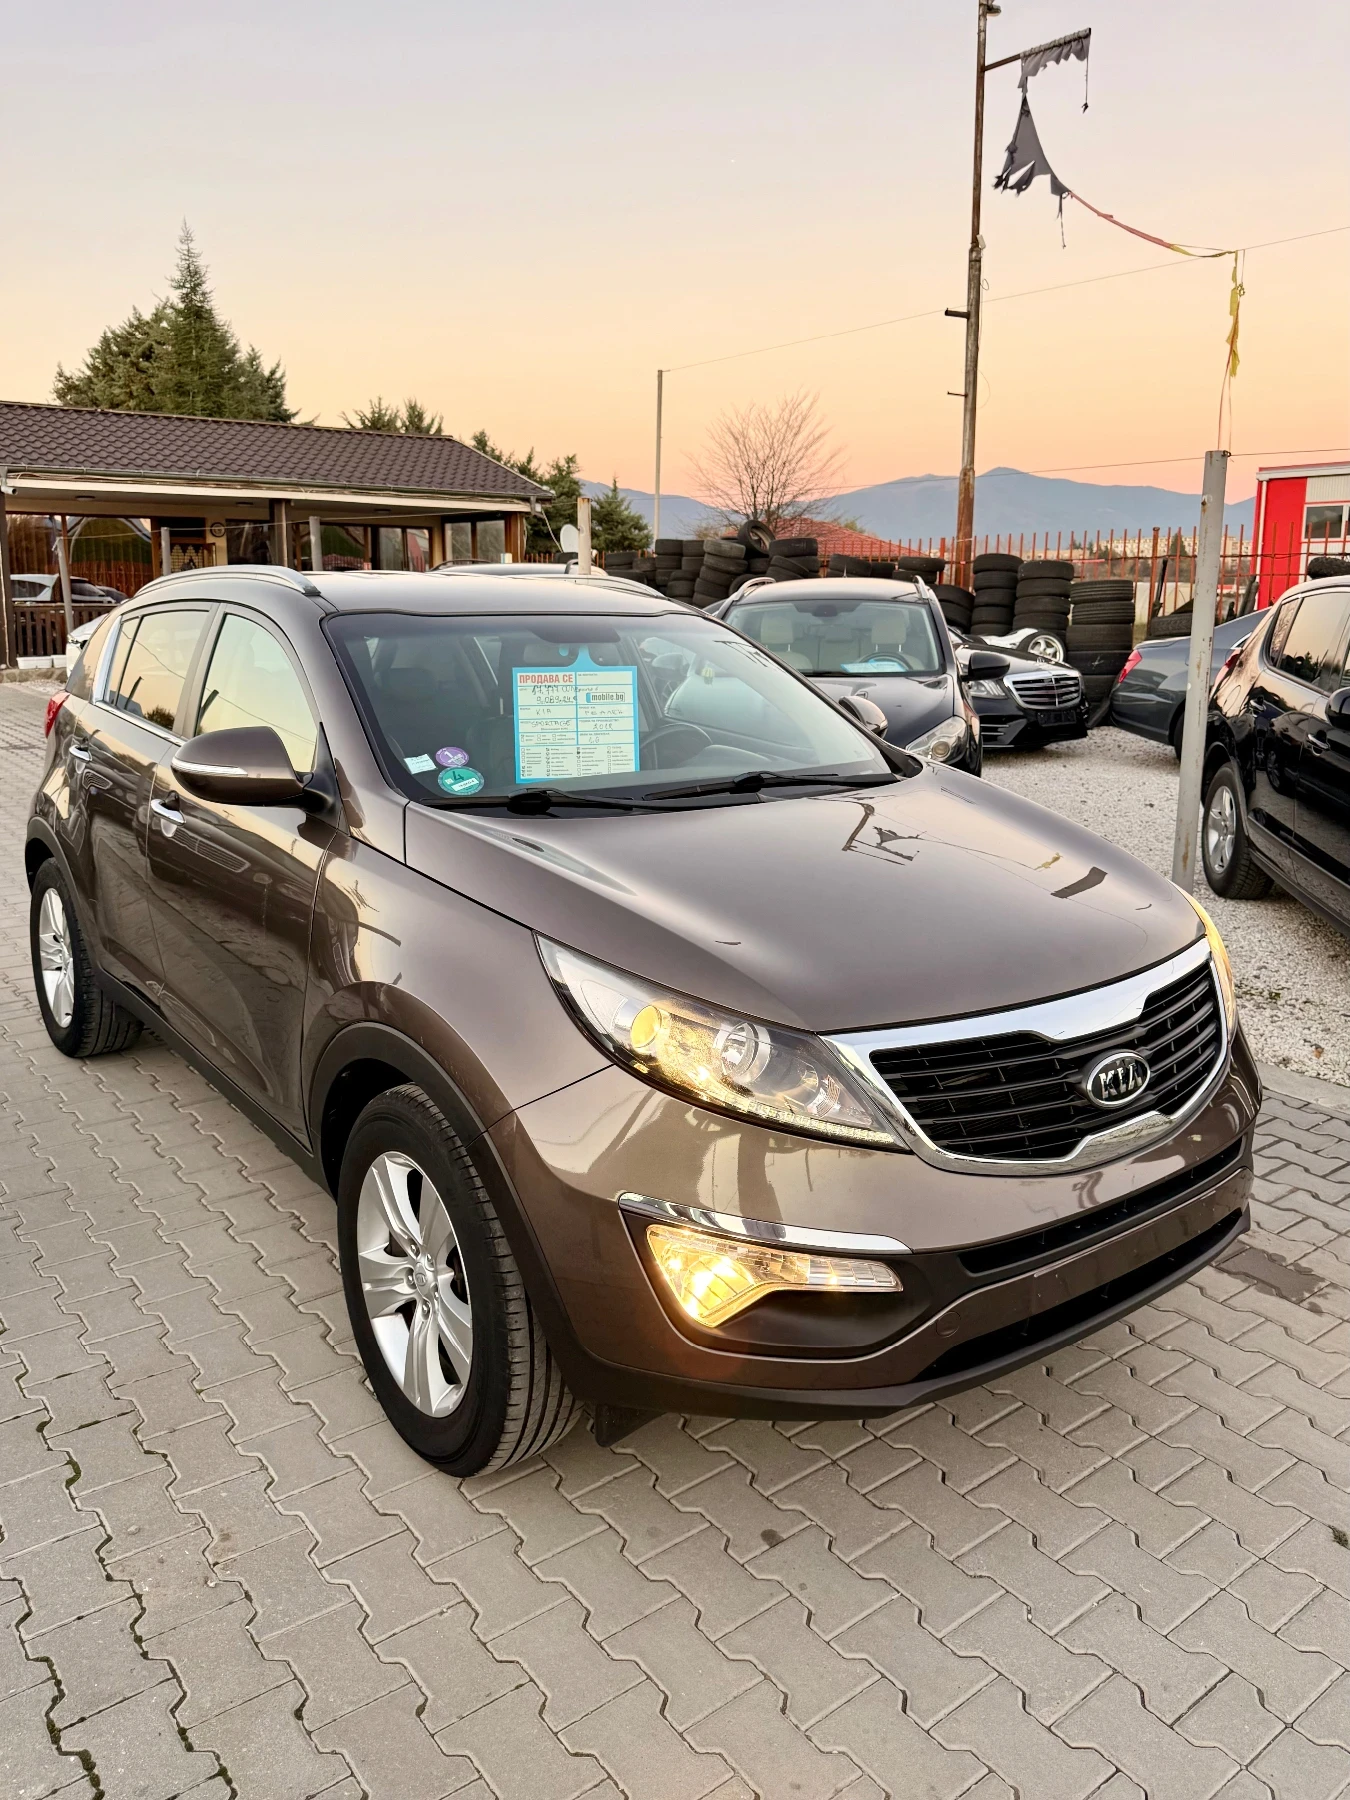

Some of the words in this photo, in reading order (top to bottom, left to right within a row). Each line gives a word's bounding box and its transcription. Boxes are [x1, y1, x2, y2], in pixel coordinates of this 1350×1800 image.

[519, 674, 560, 684] ПРОДАВА
[562, 674, 573, 683] СЕ
[591, 693, 624, 702] mobile.bg
[1098, 1063, 1143, 1100] KIA
